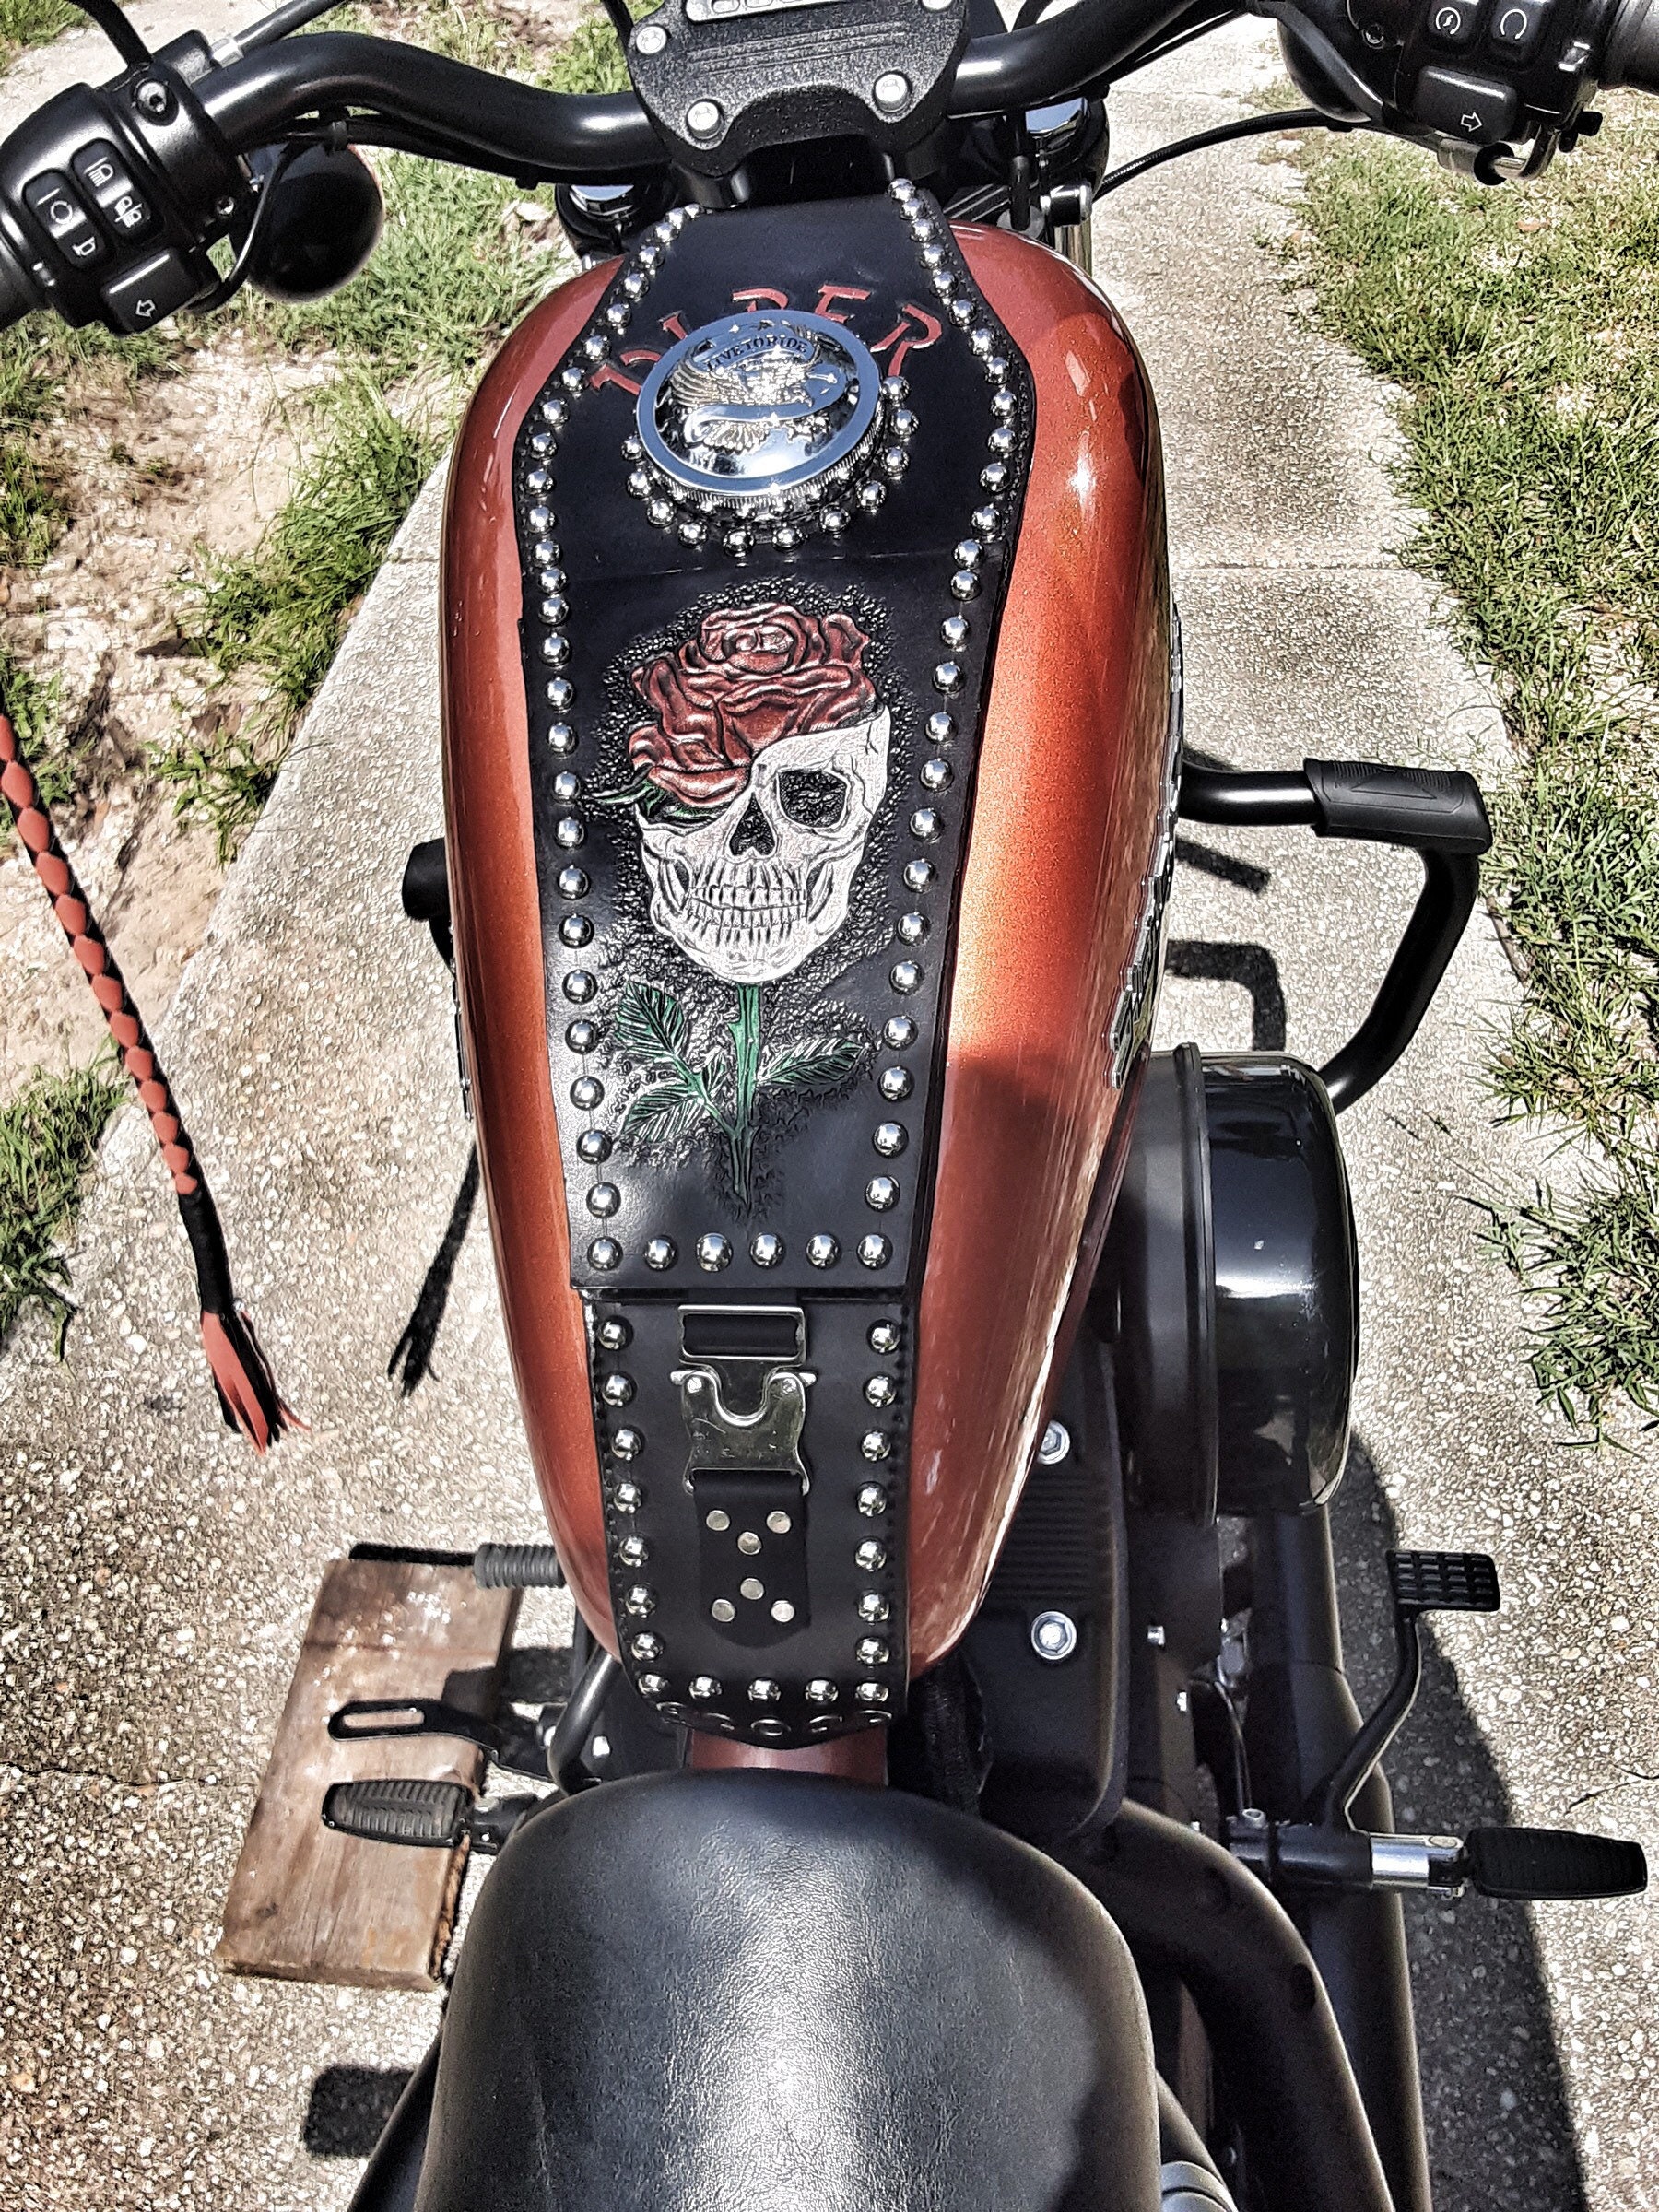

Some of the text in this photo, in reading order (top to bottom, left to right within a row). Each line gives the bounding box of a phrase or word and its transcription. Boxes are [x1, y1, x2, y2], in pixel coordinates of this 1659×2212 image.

[703, 334, 808, 371] LIVE TO RIDE
